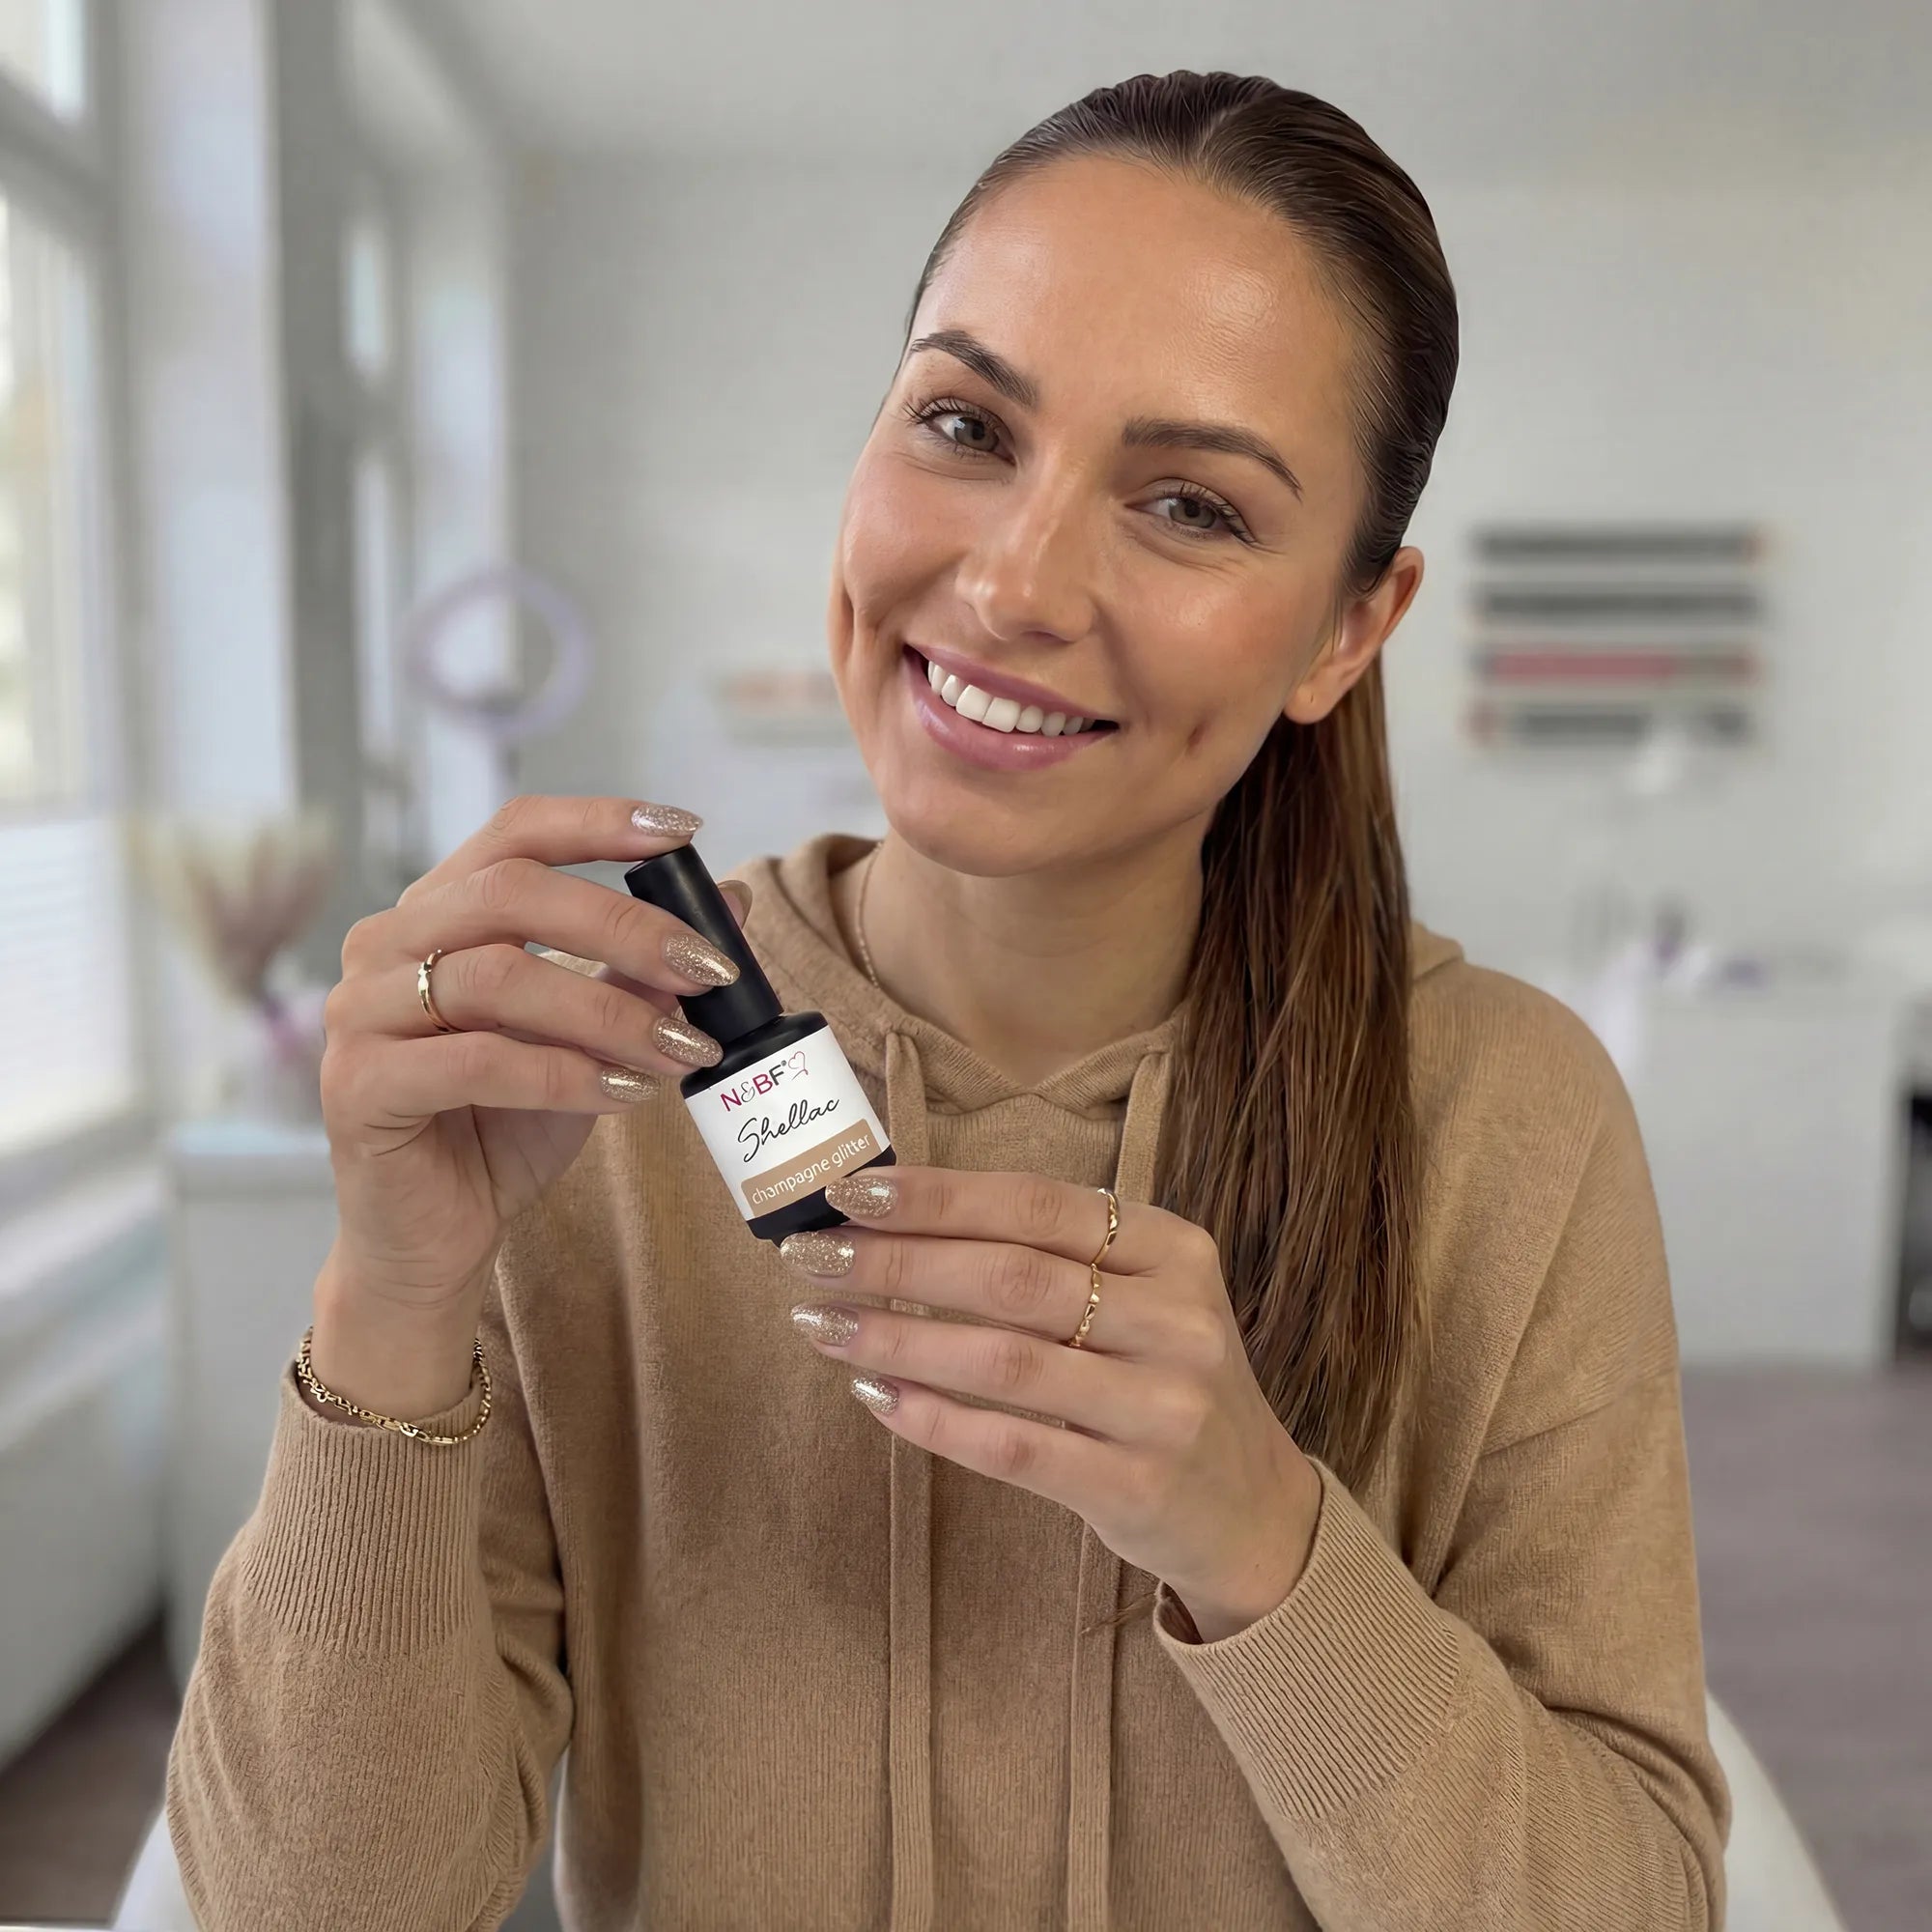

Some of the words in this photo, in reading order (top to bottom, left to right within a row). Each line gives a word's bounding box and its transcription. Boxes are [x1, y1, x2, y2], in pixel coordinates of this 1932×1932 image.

[737, 1098, 840, 1163] Shellac
[752, 1158, 831, 1205] champagne
[831, 1134, 870, 1168] glitter
